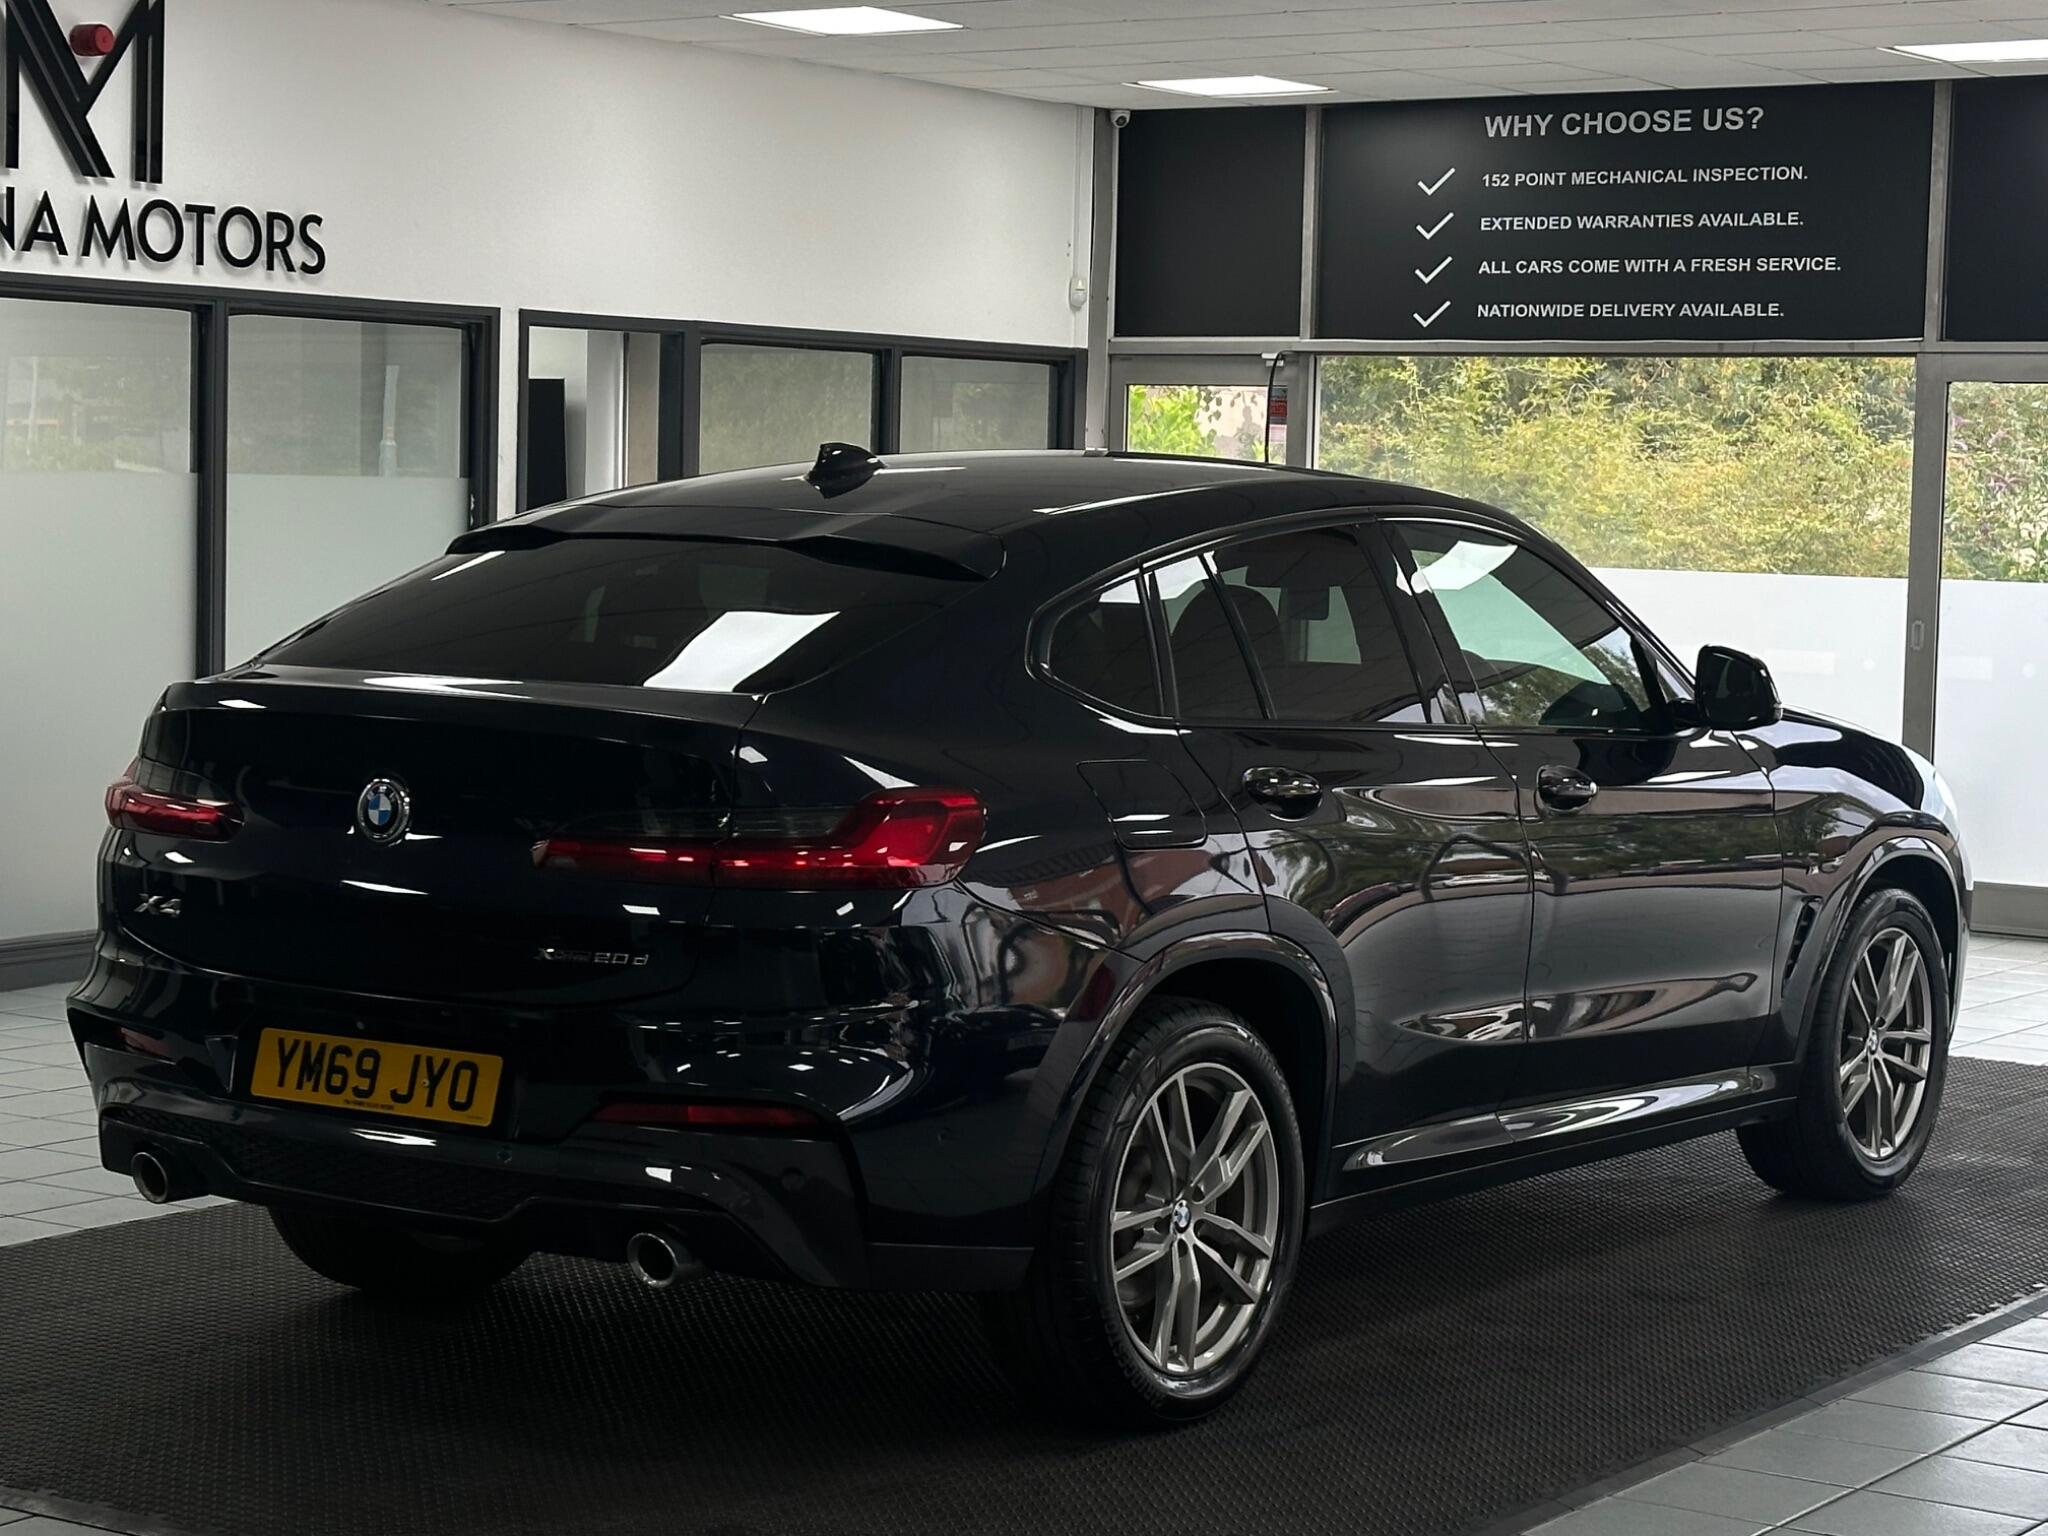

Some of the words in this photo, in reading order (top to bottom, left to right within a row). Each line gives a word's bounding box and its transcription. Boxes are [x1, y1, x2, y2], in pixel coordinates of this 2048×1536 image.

[1484, 113, 1554, 138] WHY
[1561, 109, 1692, 136] CHOOSE
[1703, 106, 1764, 131] US?
[1481, 173, 1510, 188] 152
[1514, 171, 1567, 187] POINT
[1571, 168, 1688, 186] MECHANICAL
[1692, 165, 1808, 183] INSPECTION.
[1480, 215, 1573, 232] EXTENDED
[1576, 213, 1694, 230] WARRANTIES
[1697, 211, 1804, 228] AVAILABLE.
[81, 195, 326, 275] MOTORS
[1477, 260, 1511, 275] ALL
[1515, 259, 1564, 275] CARS
[1567, 259, 1620, 274] COME
[1624, 258, 1669, 273] WITH
[1672, 258, 1687, 273] A
[1690, 257, 1751, 273] FRESH
[1755, 256, 1842, 272] SERVICE.
[1477, 303, 1585, 318] NATIONWIDE
[1589, 303, 1676, 318] DELIVERY
[1678, 302, 1785, 317] AVAILABLE.
[133, 892, 181, 917] X4
[276, 1036, 382, 1099] YM69
[389, 1053, 480, 1112] JYO
